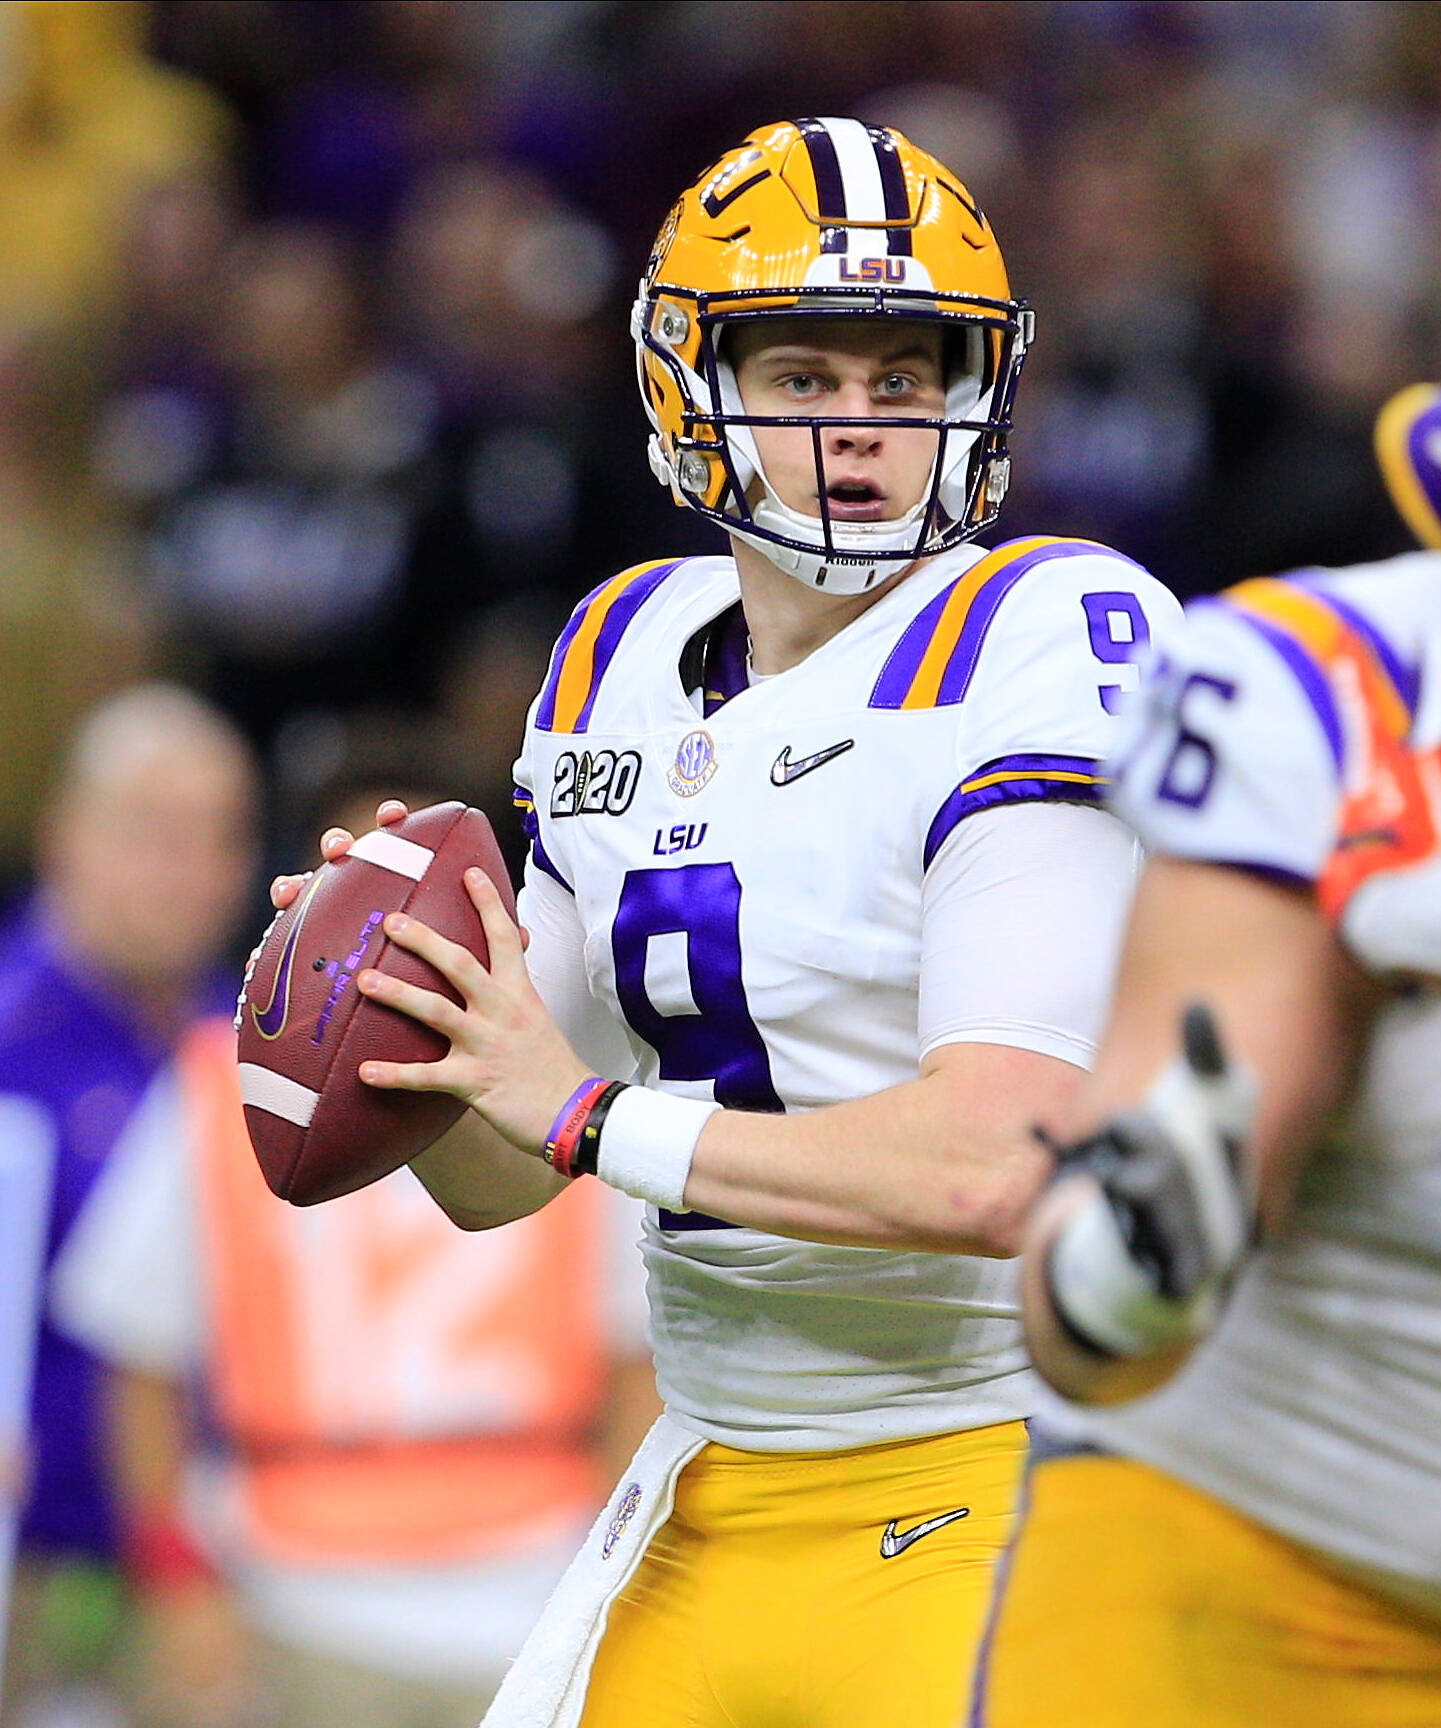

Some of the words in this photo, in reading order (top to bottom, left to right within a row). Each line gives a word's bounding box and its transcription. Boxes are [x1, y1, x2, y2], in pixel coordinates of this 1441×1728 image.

[840, 257, 905, 283] LSU
[1081, 591, 1151, 716] 9
[653, 822, 708, 856] LSU
[611, 861, 786, 1231] 9
[566, 1104, 592, 1134] BODY
